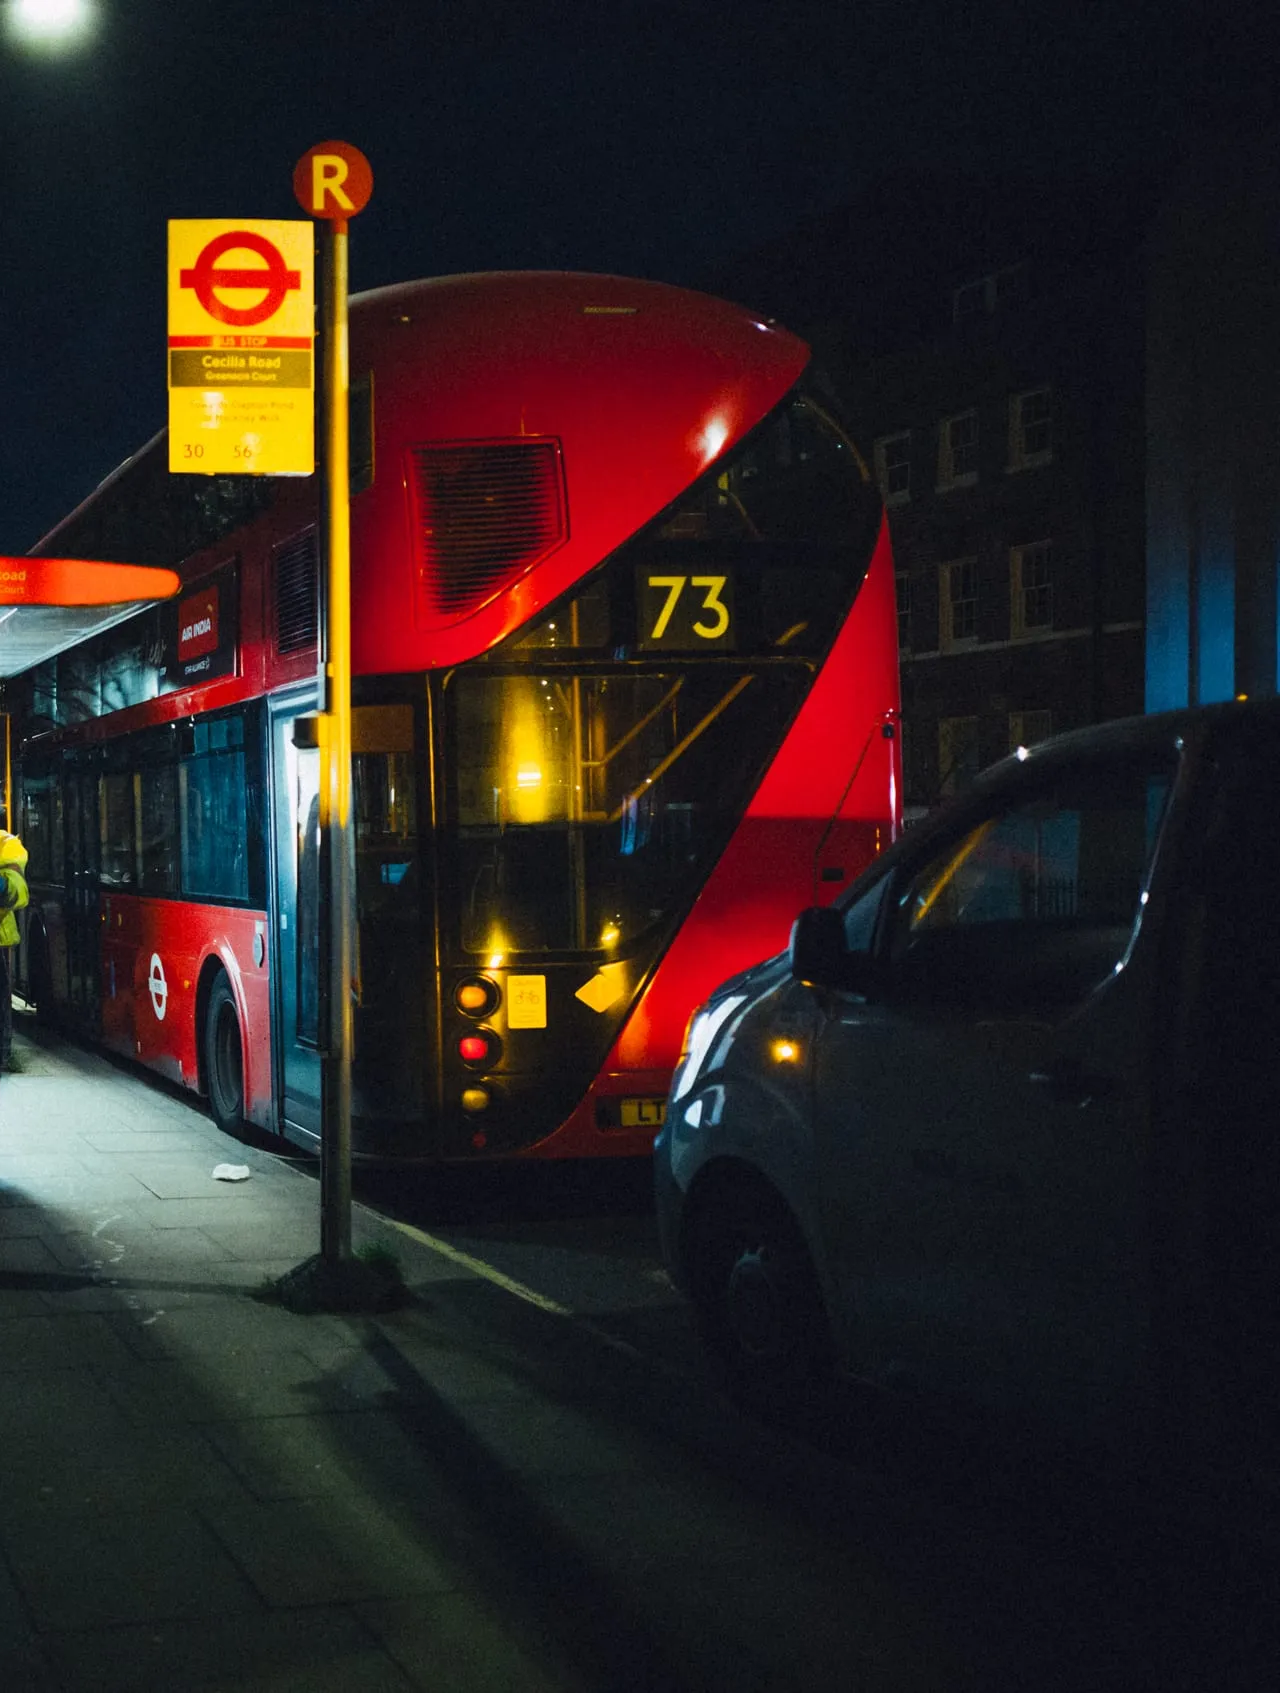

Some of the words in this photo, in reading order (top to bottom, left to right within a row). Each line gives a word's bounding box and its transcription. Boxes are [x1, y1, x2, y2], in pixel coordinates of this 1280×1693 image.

[312, 154, 355, 211] R
[201, 355, 247, 369] Cecilia
[249, 356, 281, 369] Road
[183, 444, 205, 459] 30
[234, 445, 253, 459] 56
[648, 576, 729, 639] 73
[638, 1102, 665, 1122] LT
